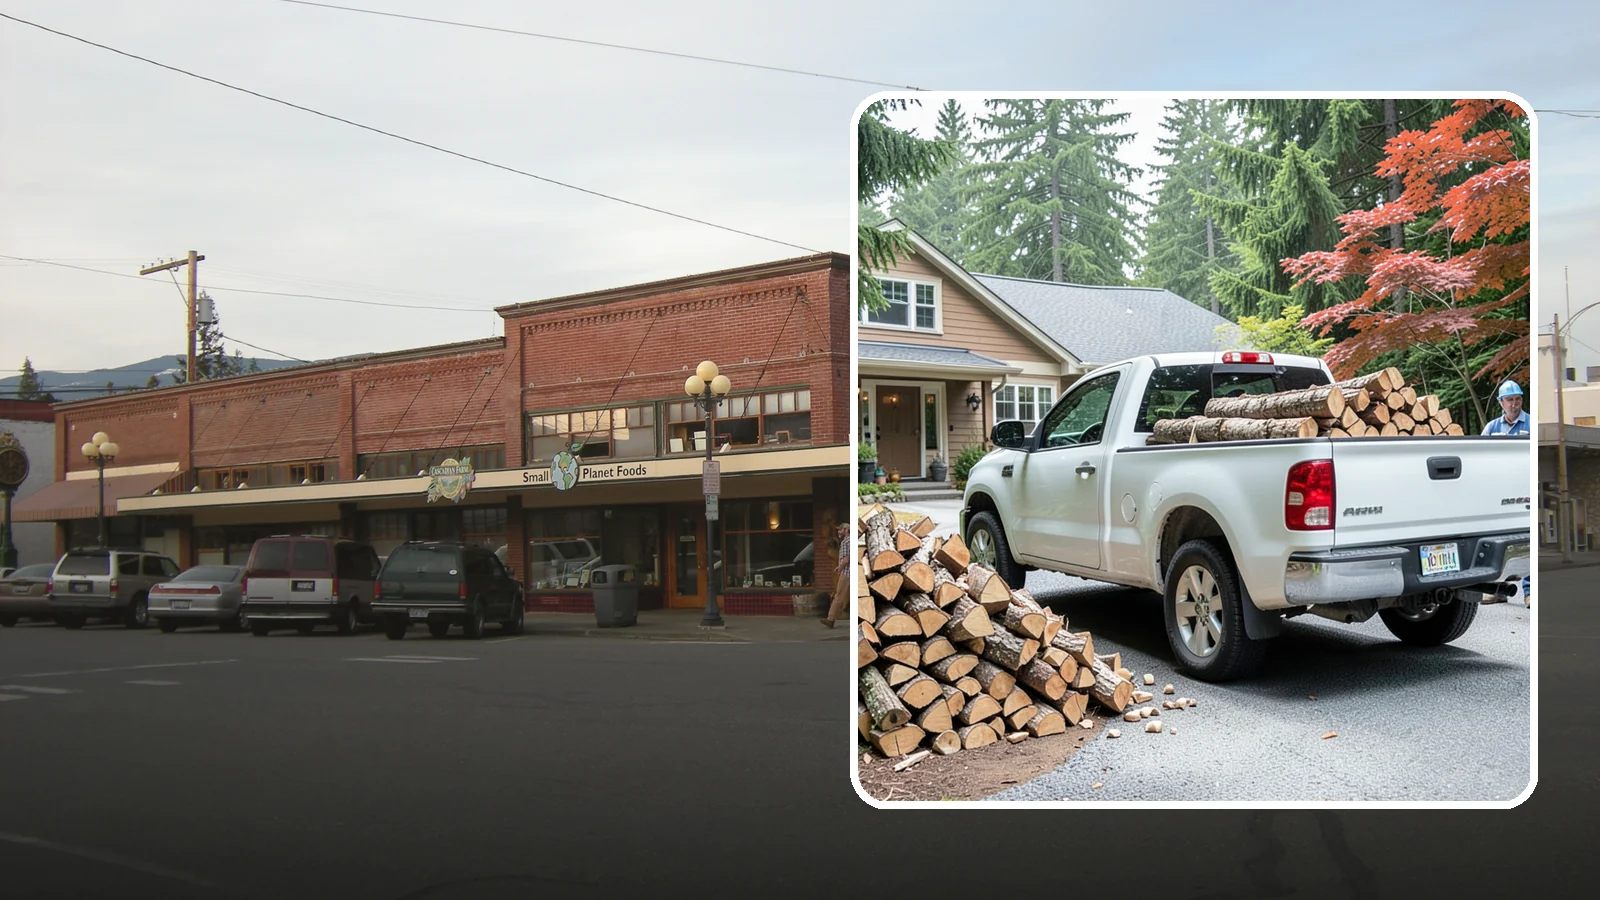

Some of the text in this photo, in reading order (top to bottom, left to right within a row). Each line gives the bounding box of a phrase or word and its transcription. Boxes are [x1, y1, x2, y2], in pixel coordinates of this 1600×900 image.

[523, 464, 647, 483] Small Planet Foods
